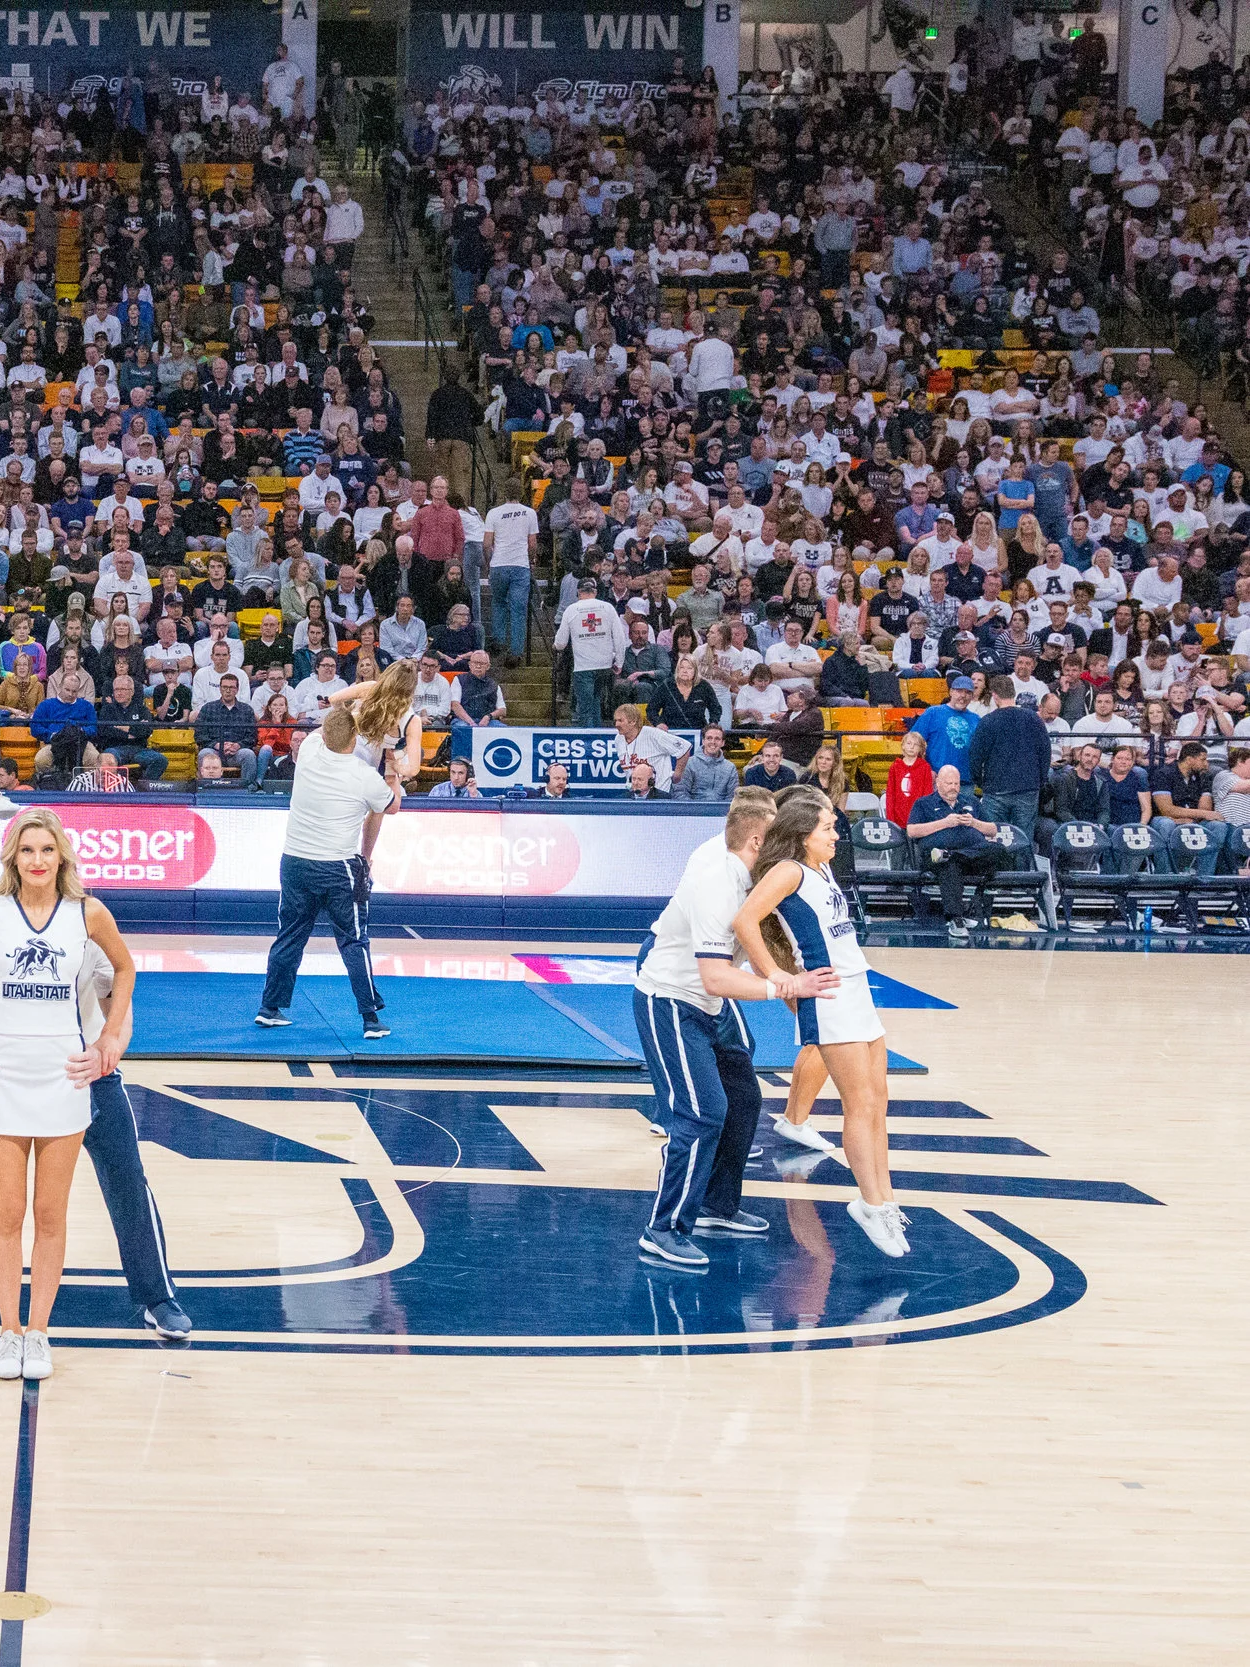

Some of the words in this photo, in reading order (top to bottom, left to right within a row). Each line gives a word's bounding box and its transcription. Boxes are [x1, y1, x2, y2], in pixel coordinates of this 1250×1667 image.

[292, 0, 308, 20] A
[715, 3, 731, 23] B
[1141, 5, 1159, 25] C
[136, 11, 212, 47] WE
[441, 13, 556, 49] WILL
[583, 14, 680, 50] WIN
[501, 511, 513, 520] JUST
[1043, 575, 1066, 595] A
[537, 739, 586, 758] CBS
[537, 758, 627, 778] NETWO
[70, 826, 195, 861] ossner
[76, 864, 166, 881] OODS
[425, 871, 529, 887] FOODS
[1, 982, 34, 999] UTAH
[34, 983, 71, 1000] STATE
